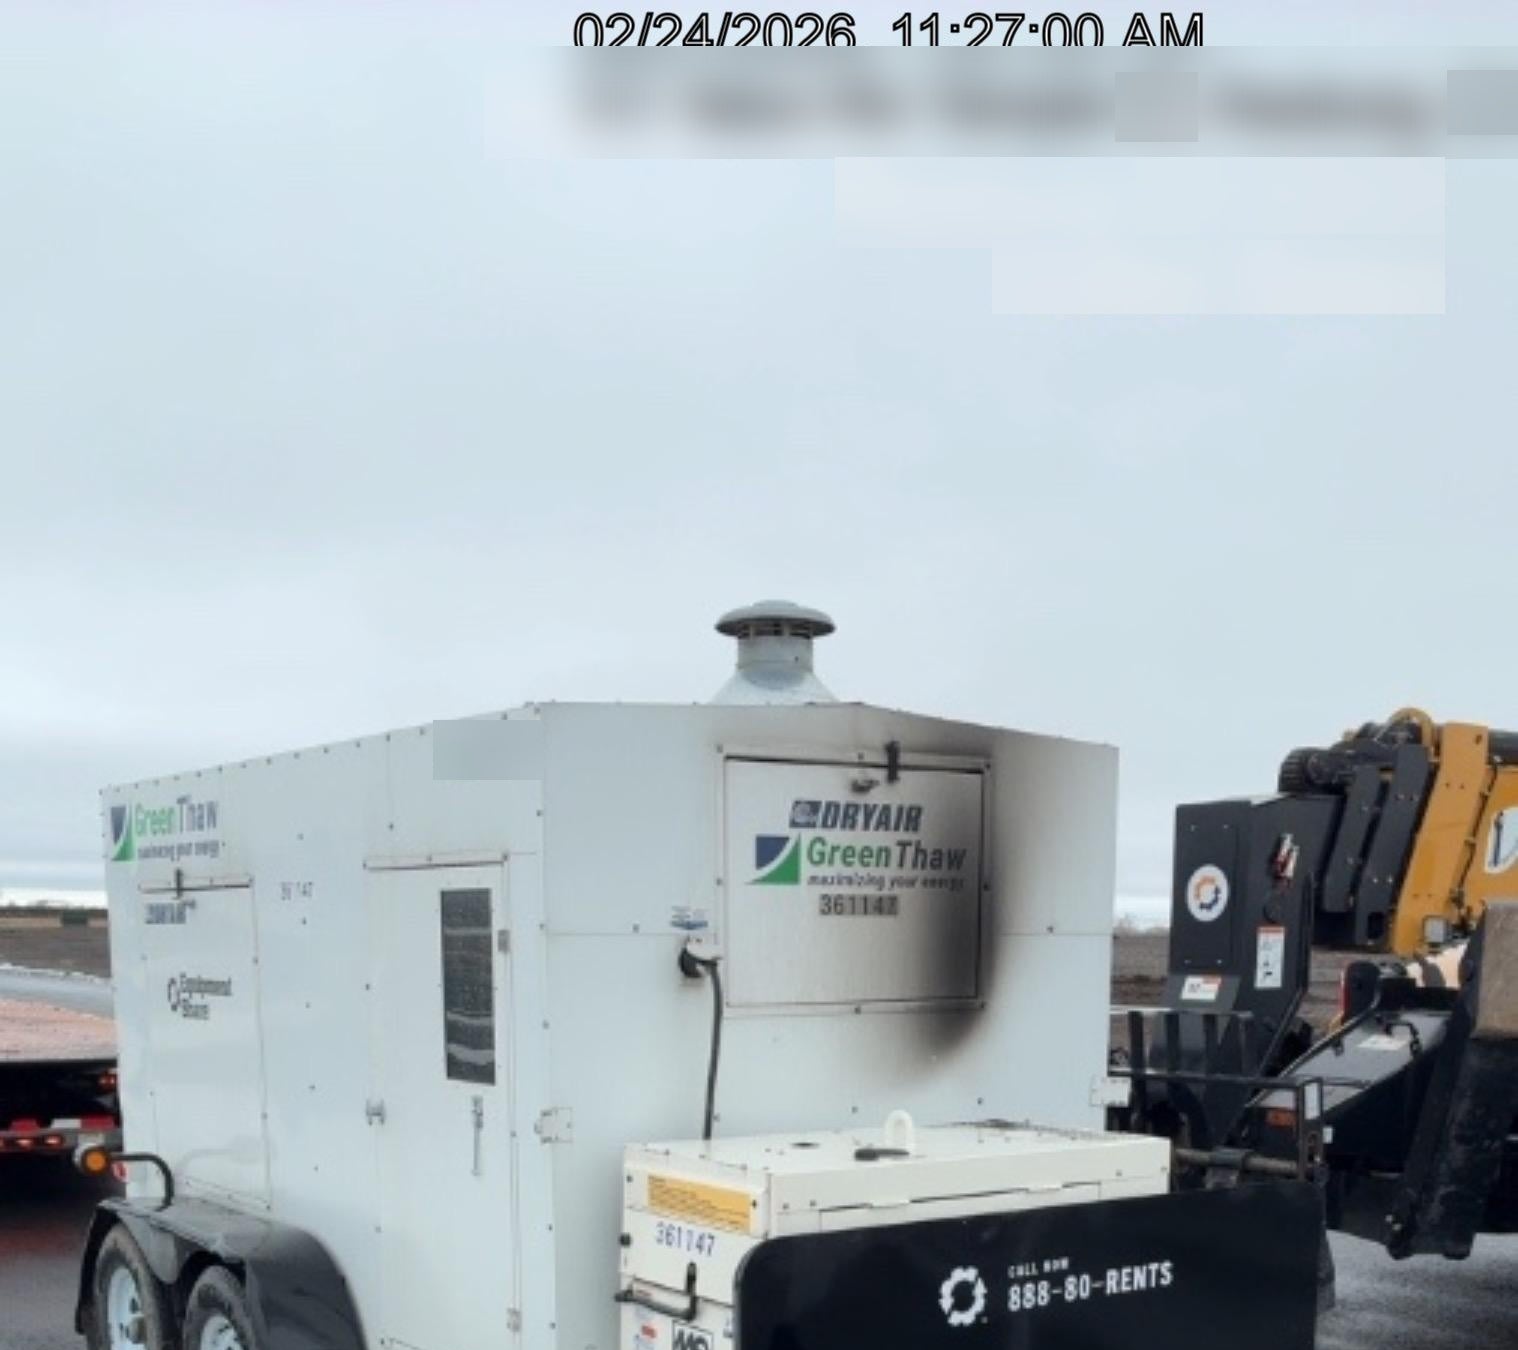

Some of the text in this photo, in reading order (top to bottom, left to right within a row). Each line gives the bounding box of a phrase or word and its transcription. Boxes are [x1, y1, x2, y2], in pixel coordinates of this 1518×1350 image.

[820, 801, 923, 832] DRYAIR
[807, 873, 886, 891] maximizing
[656, 1221, 715, 1256] 361147
[1007, 1260, 1173, 1312] 888-80-RENTS
